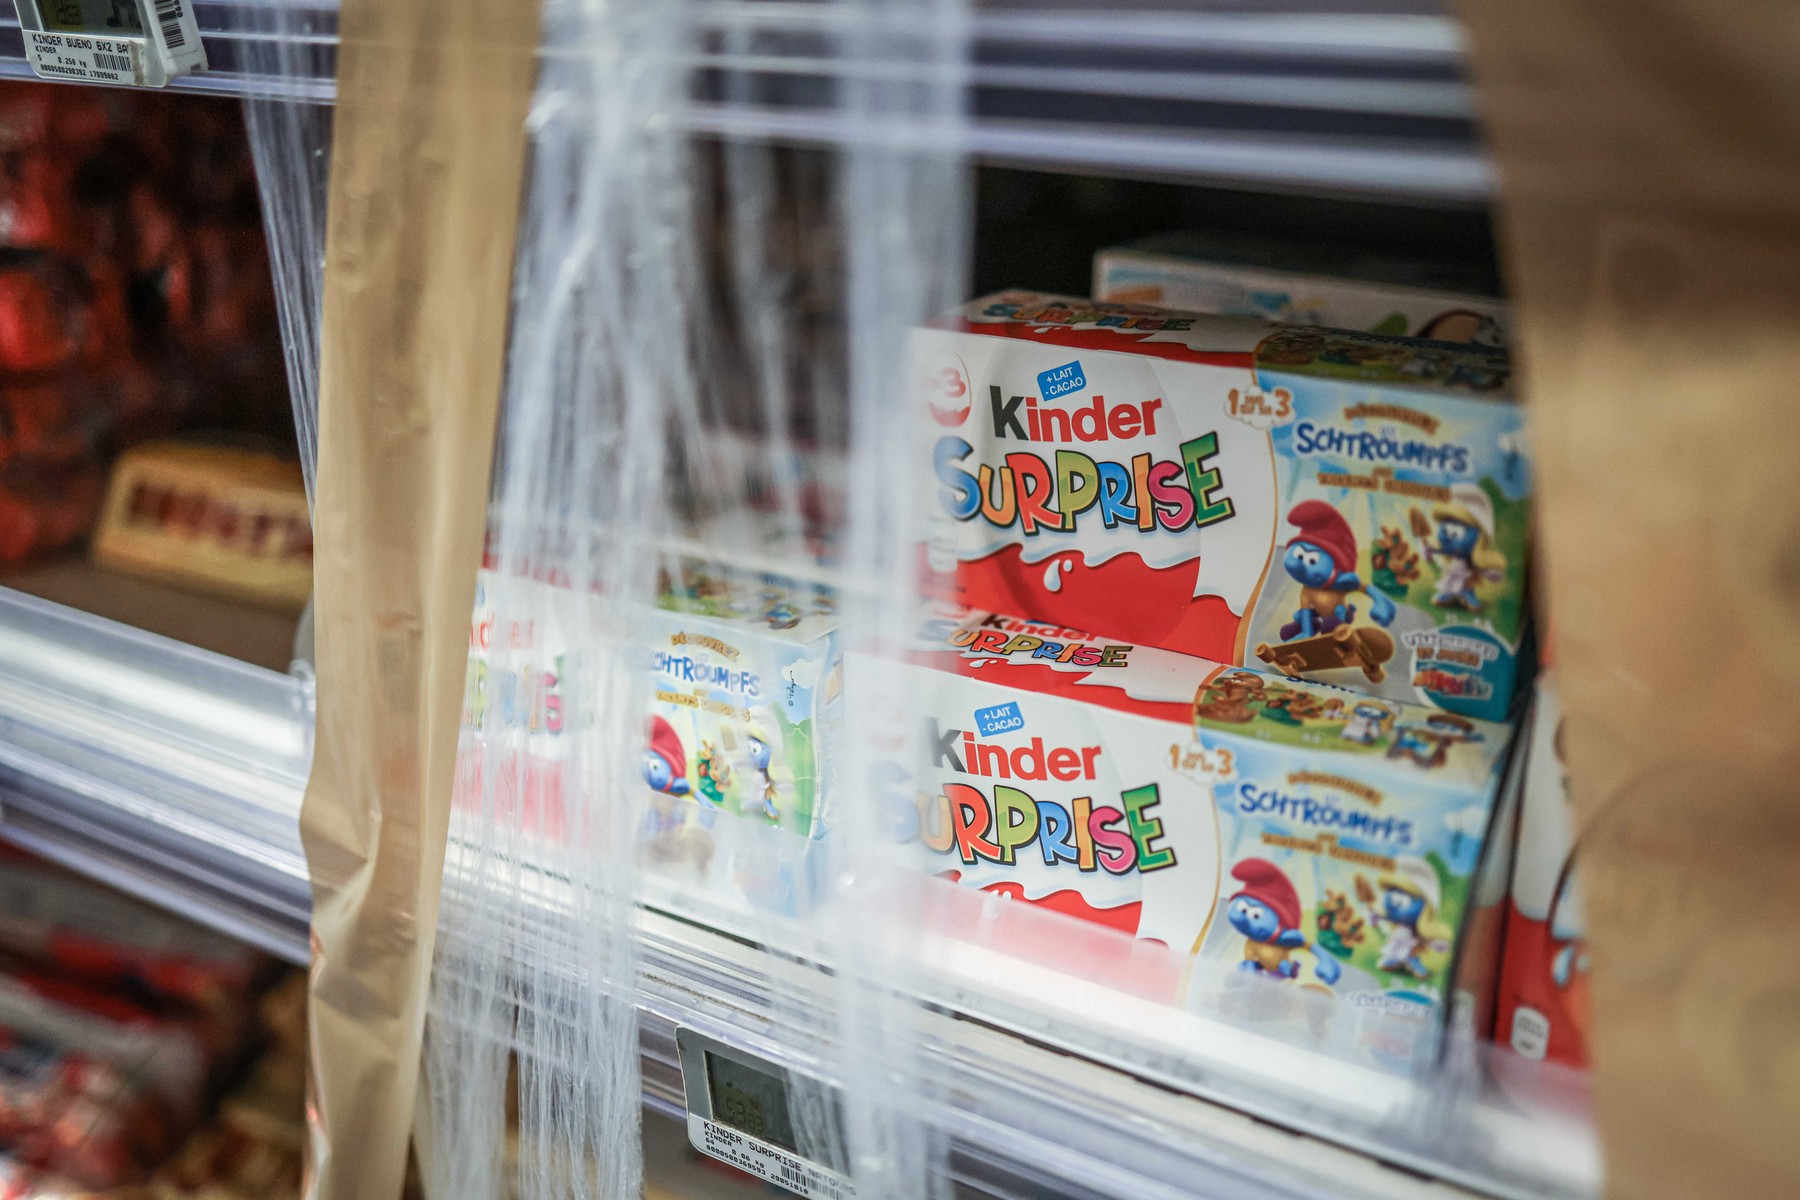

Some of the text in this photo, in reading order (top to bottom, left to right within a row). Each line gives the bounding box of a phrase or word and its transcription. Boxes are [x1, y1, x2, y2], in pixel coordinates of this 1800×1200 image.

[32, 34, 130, 54] KINDER BUENO 6X2 BA
[35, 45, 57, 54] KINDER
[1052, 367, 1073, 382] LAIT
[1049, 377, 1083, 396] CACAO
[932, 431, 1236, 537] SURPRISE
[917, 618, 1134, 668] SURPRISE
[990, 706, 1011, 720] LAIT
[986, 716, 1022, 733] CACAO
[703, 1121, 743, 1146] KINDER
[749, 1141, 802, 1172] SURPRISE
[705, 1130, 732, 1148] KINDER
